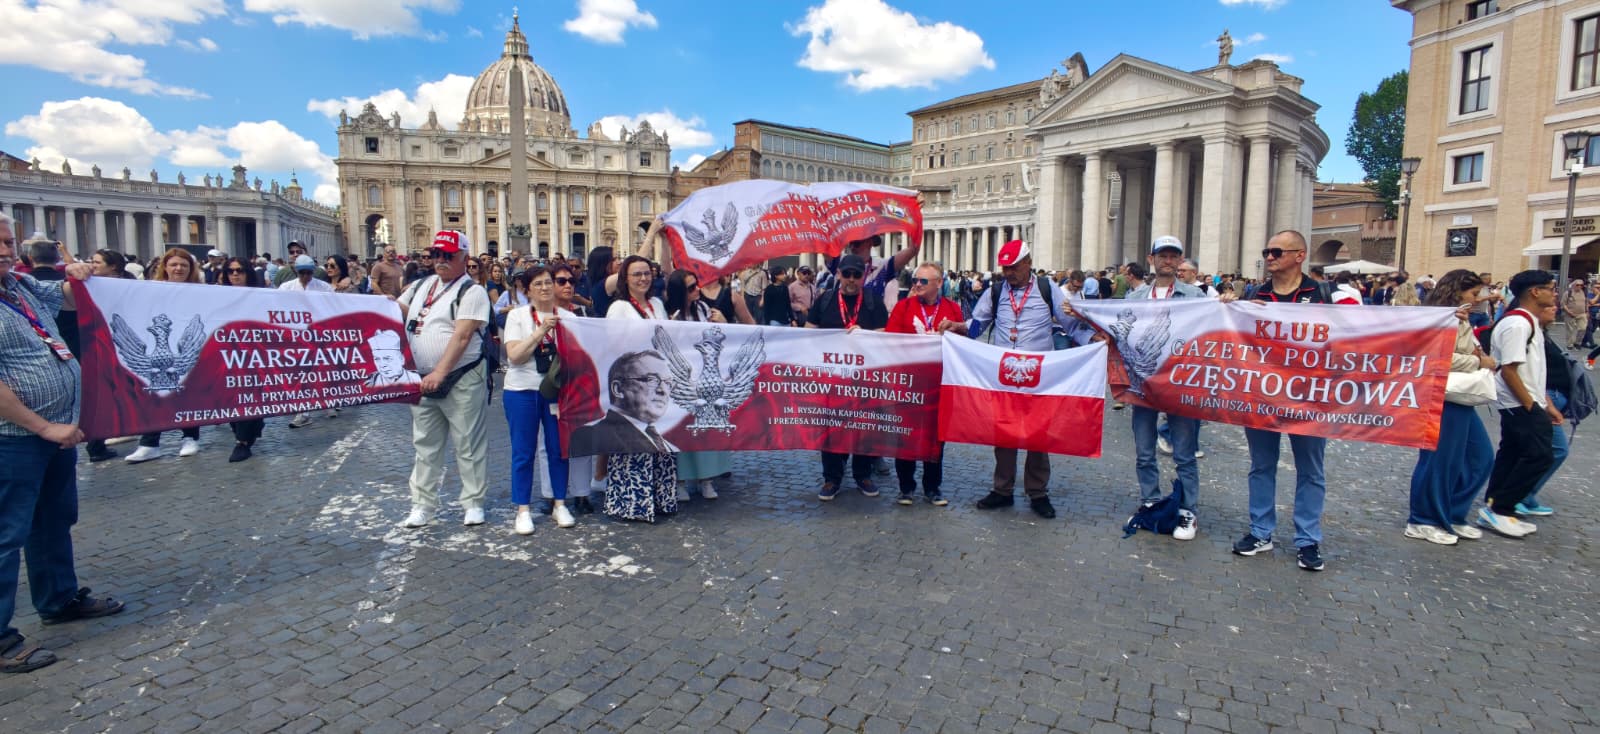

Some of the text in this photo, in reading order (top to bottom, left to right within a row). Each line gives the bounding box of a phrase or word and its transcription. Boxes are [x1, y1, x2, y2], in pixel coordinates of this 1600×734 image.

[750, 217, 798, 233] PERTH
[1555, 218, 1595, 227] EMORIO
[268, 310, 313, 324] KLUB
[214, 329, 364, 344] GAZETY POLSKIEJ
[1255, 319, 1330, 342] KLUB
[220, 346, 366, 369] WARSZAWA
[823, 352, 865, 366] KLUB
[1171, 339, 1427, 378] GAZETY POLSKIEJ
[226, 368, 368, 388] BIELANY-ŻOLIBORZ
[772, 365, 914, 388] GAZETY POLSKIEJ
[1169, 363, 1419, 408] CZĘSTOCHOWA
[238, 385, 363, 404] IM. PRYMASA POLSKI
[758, 380, 925, 404] PIOTRKÓW TRYBUNALSKI
[174, 408, 240, 423] STEFANA
[244, 401, 322, 417] KARDYNAŁA
[838, 409, 903, 423] KAPUŚCIŃSKIEGO
[1181, 393, 1394, 427] IM. JANUSZA KOCHANOWSKIEGO
[773, 417, 809, 425] PREZESA
